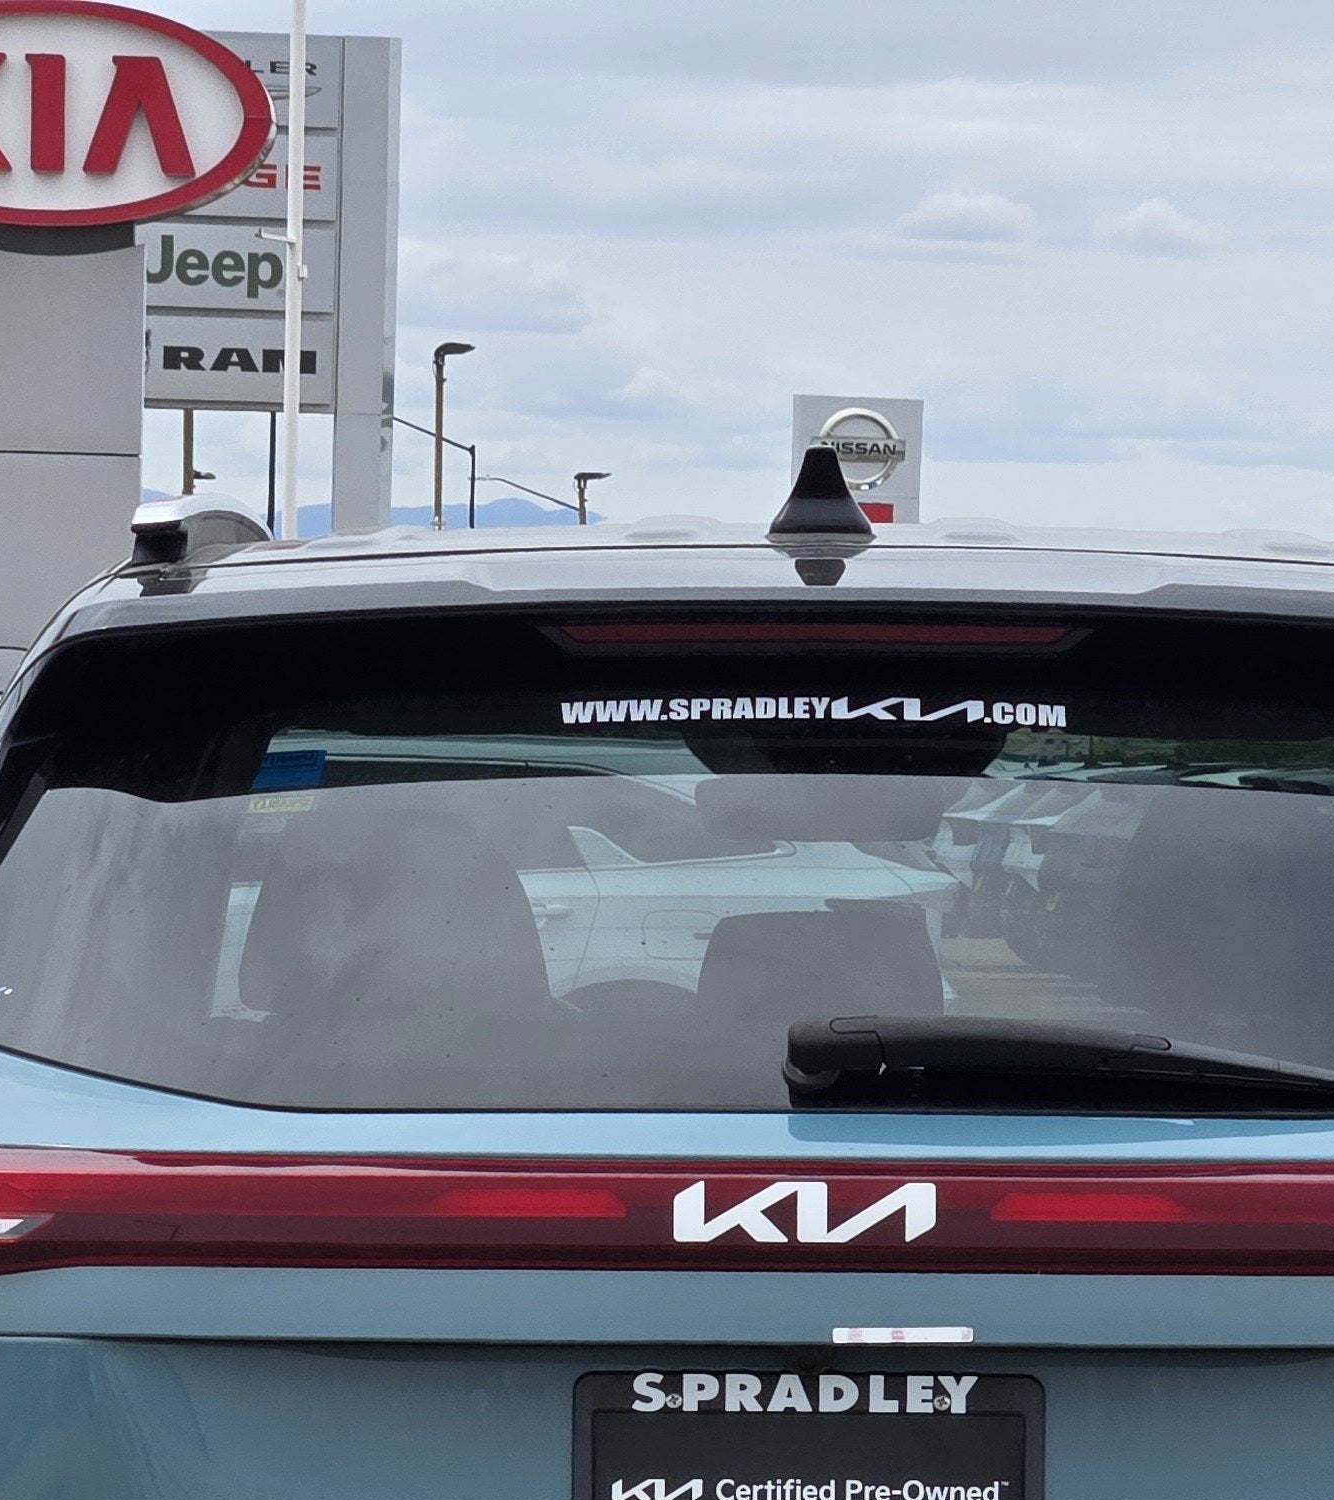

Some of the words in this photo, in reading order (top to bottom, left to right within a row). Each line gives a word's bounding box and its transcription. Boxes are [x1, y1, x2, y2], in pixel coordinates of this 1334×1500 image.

[146, 234, 283, 299] Jeep
[163, 345, 317, 375] RAM
[673, 1180, 937, 1243] KIA
[631, 1372, 978, 1414] SPRADLEY
[611, 1478, 704, 1500] KIA
